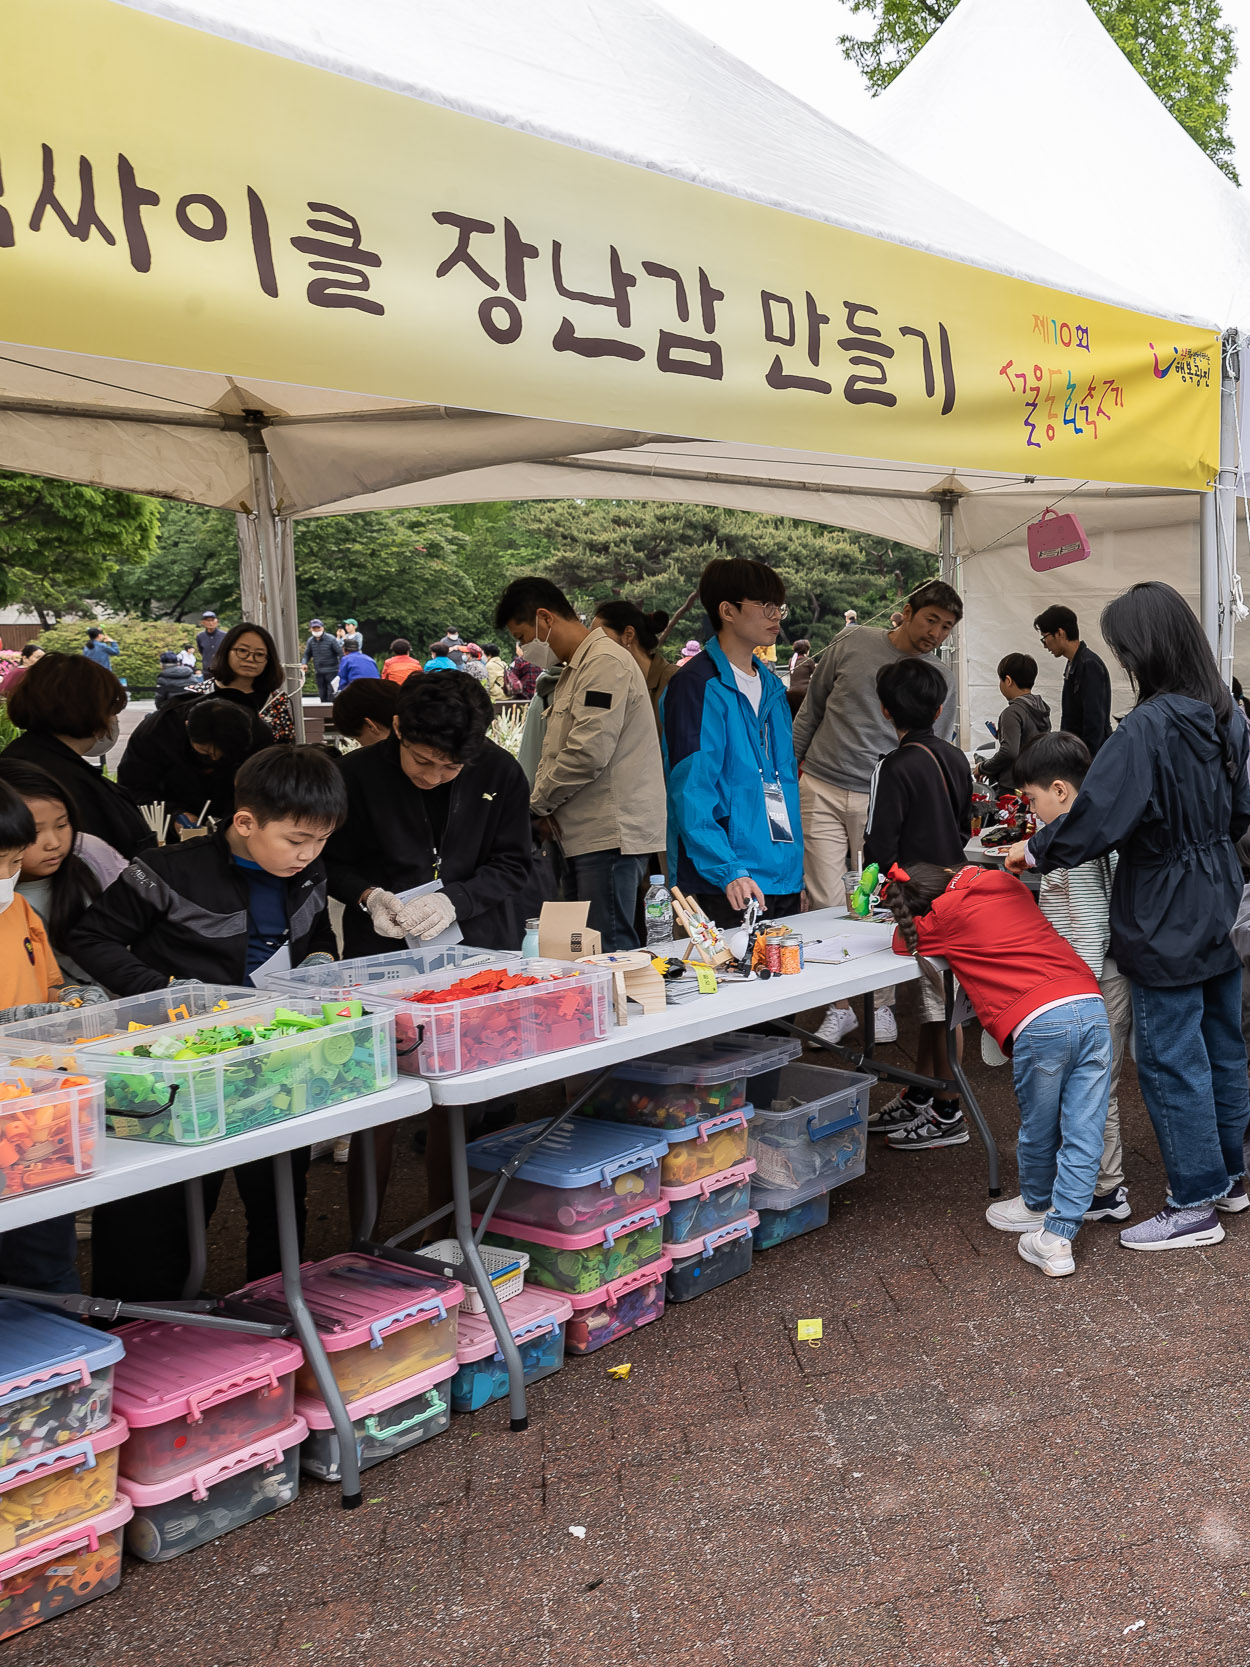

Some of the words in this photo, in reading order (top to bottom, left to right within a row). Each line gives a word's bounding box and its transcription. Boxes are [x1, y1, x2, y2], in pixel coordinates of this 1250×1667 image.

[0, 143, 385, 316] 싸이클
[431, 211, 725, 381] 장난감
[759, 289, 957, 416] 만들기
[1032, 313, 1091, 353] 제10회
[999, 359, 1124, 448] 서울동화축제
